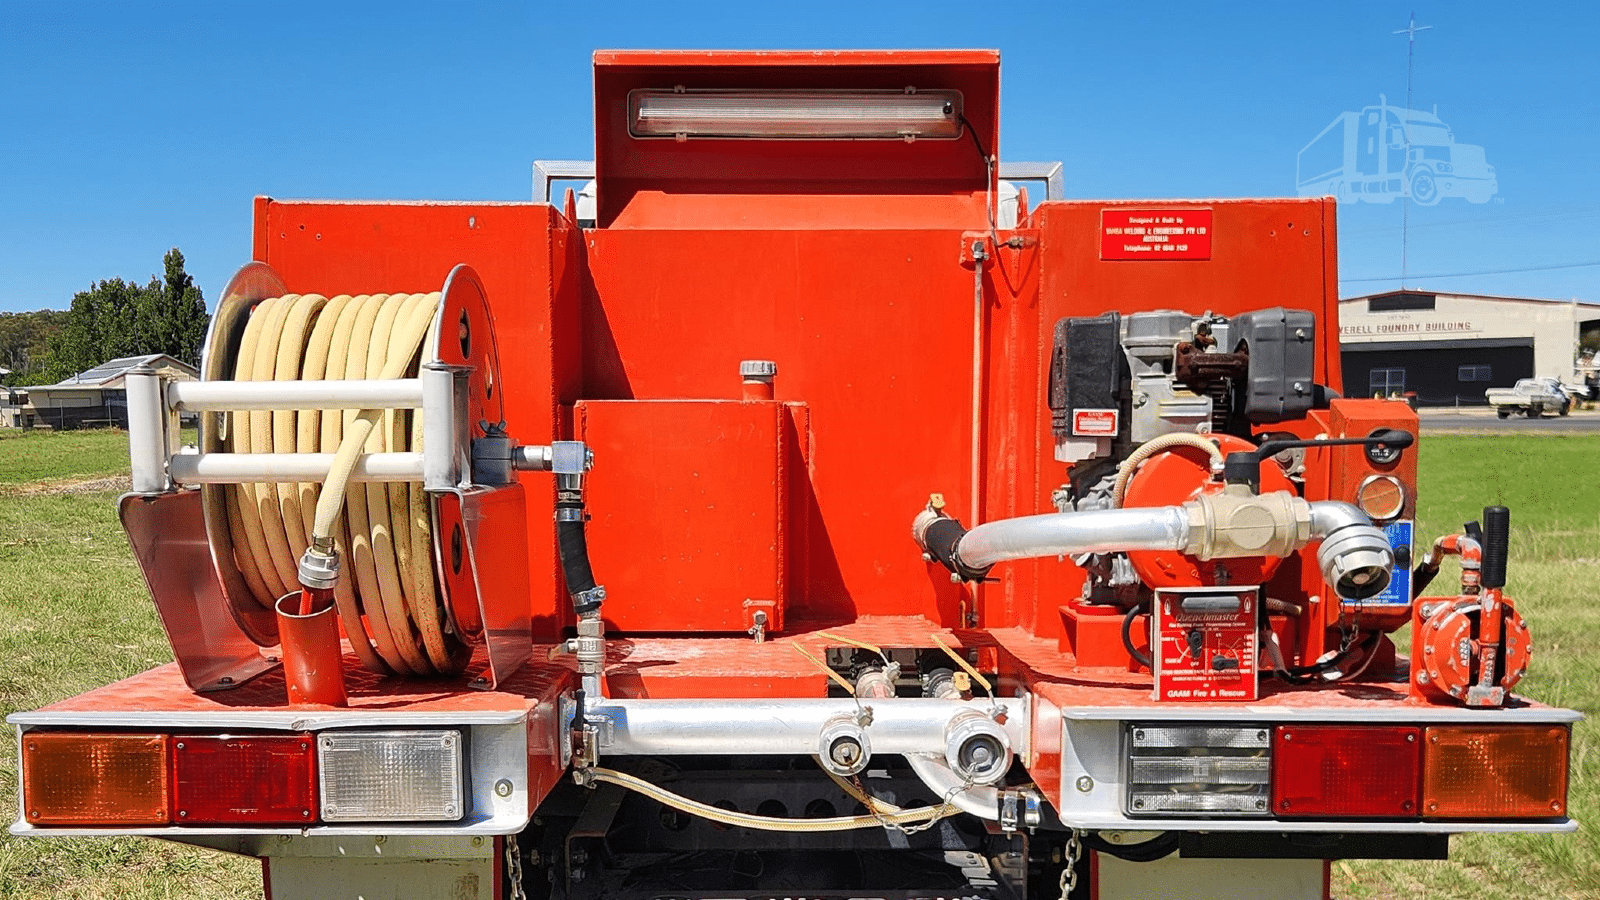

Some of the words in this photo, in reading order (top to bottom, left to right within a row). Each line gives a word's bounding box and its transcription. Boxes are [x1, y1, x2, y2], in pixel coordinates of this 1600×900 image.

[1123, 227, 1146, 235] WELDING
[1153, 227, 1185, 235] ENGINEERING
[1185, 227, 1196, 235] PTY
[1196, 227, 1207, 235] LTD
[1142, 235, 1169, 243] AUSTRALIA
[1376, 323, 1421, 333] FOUNDRY
[1425, 321, 1472, 331] BUILDING
[1175, 613, 1240, 622] Quenchmaster
[1167, 690, 1191, 698] GAAM
[1193, 689, 1207, 697] Fire
[1219, 689, 1246, 697] Rescue
